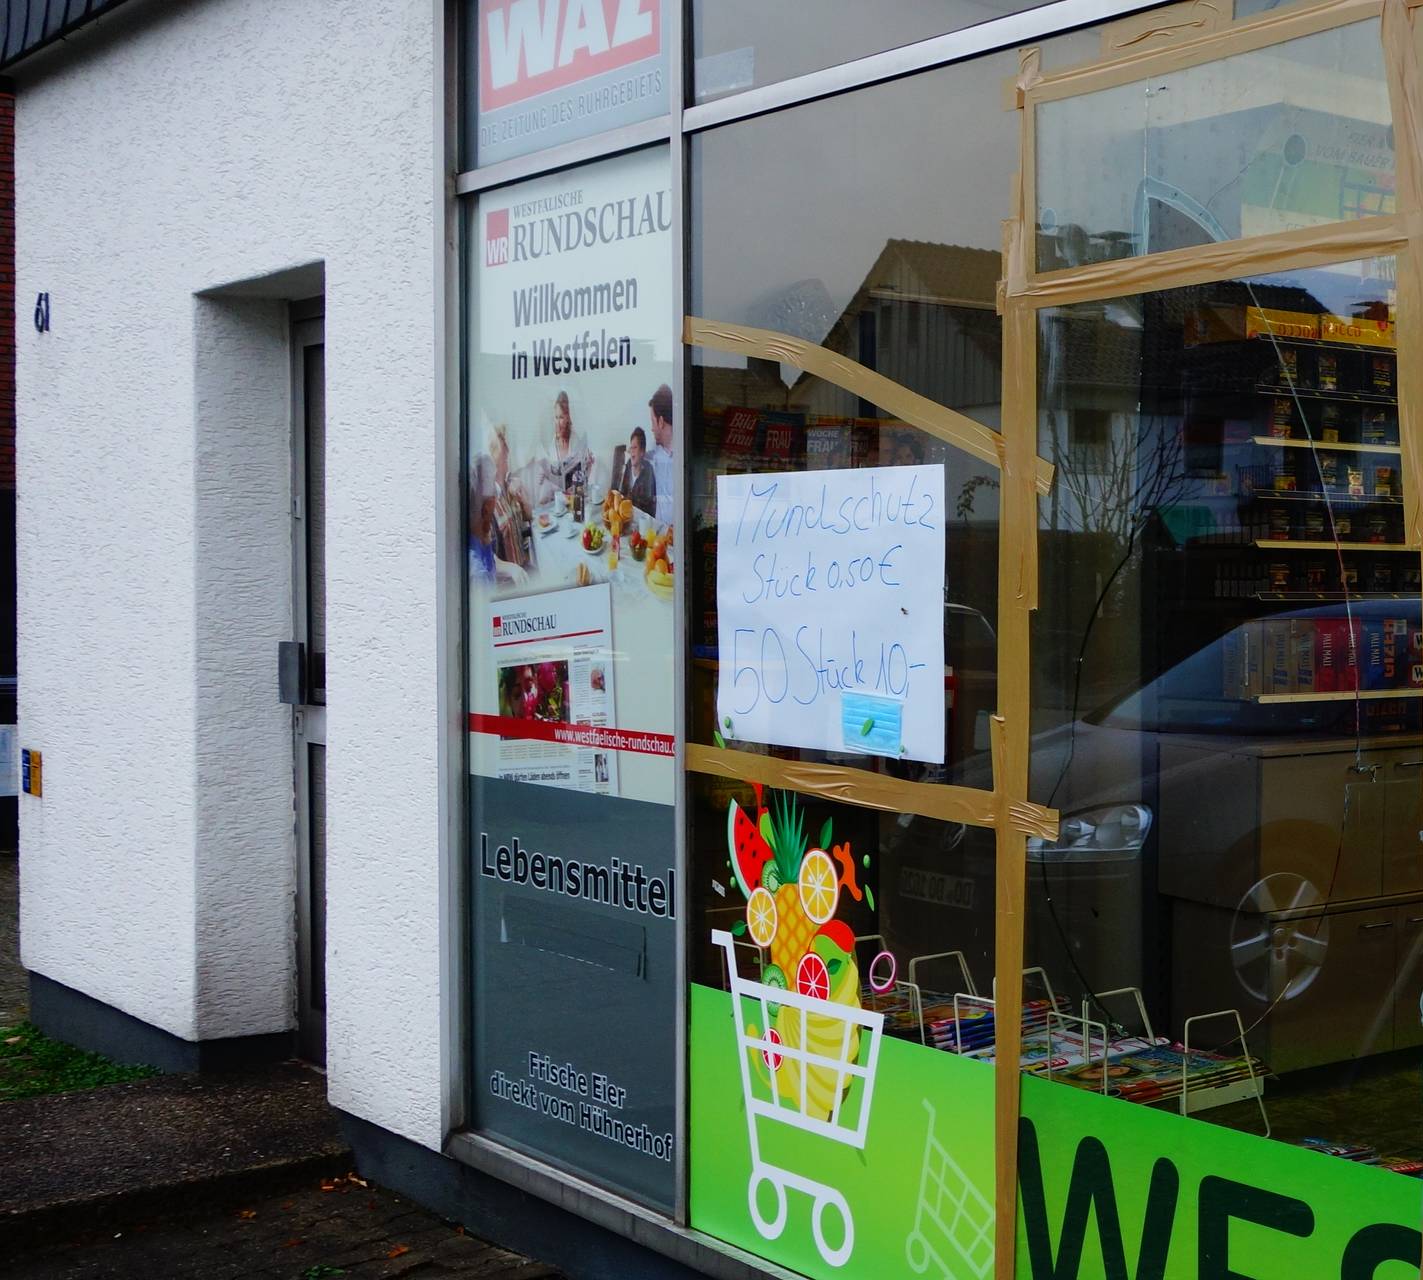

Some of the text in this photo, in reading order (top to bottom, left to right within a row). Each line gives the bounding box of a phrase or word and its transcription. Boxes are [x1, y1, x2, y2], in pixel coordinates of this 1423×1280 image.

[487, 0, 653, 90] WAZ
[481, 70, 663, 148] DIE ZEITUNG DES RUHRGEBIETS
[487, 236, 509, 266] WR
[512, 190, 672, 263] RUNDSCHAU
[34, 292, 50, 332] 61
[513, 277, 638, 328] Willkommen
[511, 328, 637, 380] in Westfalen.
[766, 430, 791, 448] FRAU
[735, 474, 935, 546] Mundschutz
[743, 552, 816, 604] Stück
[502, 614, 557, 636] RUNDSCHAU
[480, 832, 676, 920] Lebensmittel
[528, 1051, 626, 1109] Frische Eier
[490, 1071, 672, 1162] direkt vom Hühnerhof
